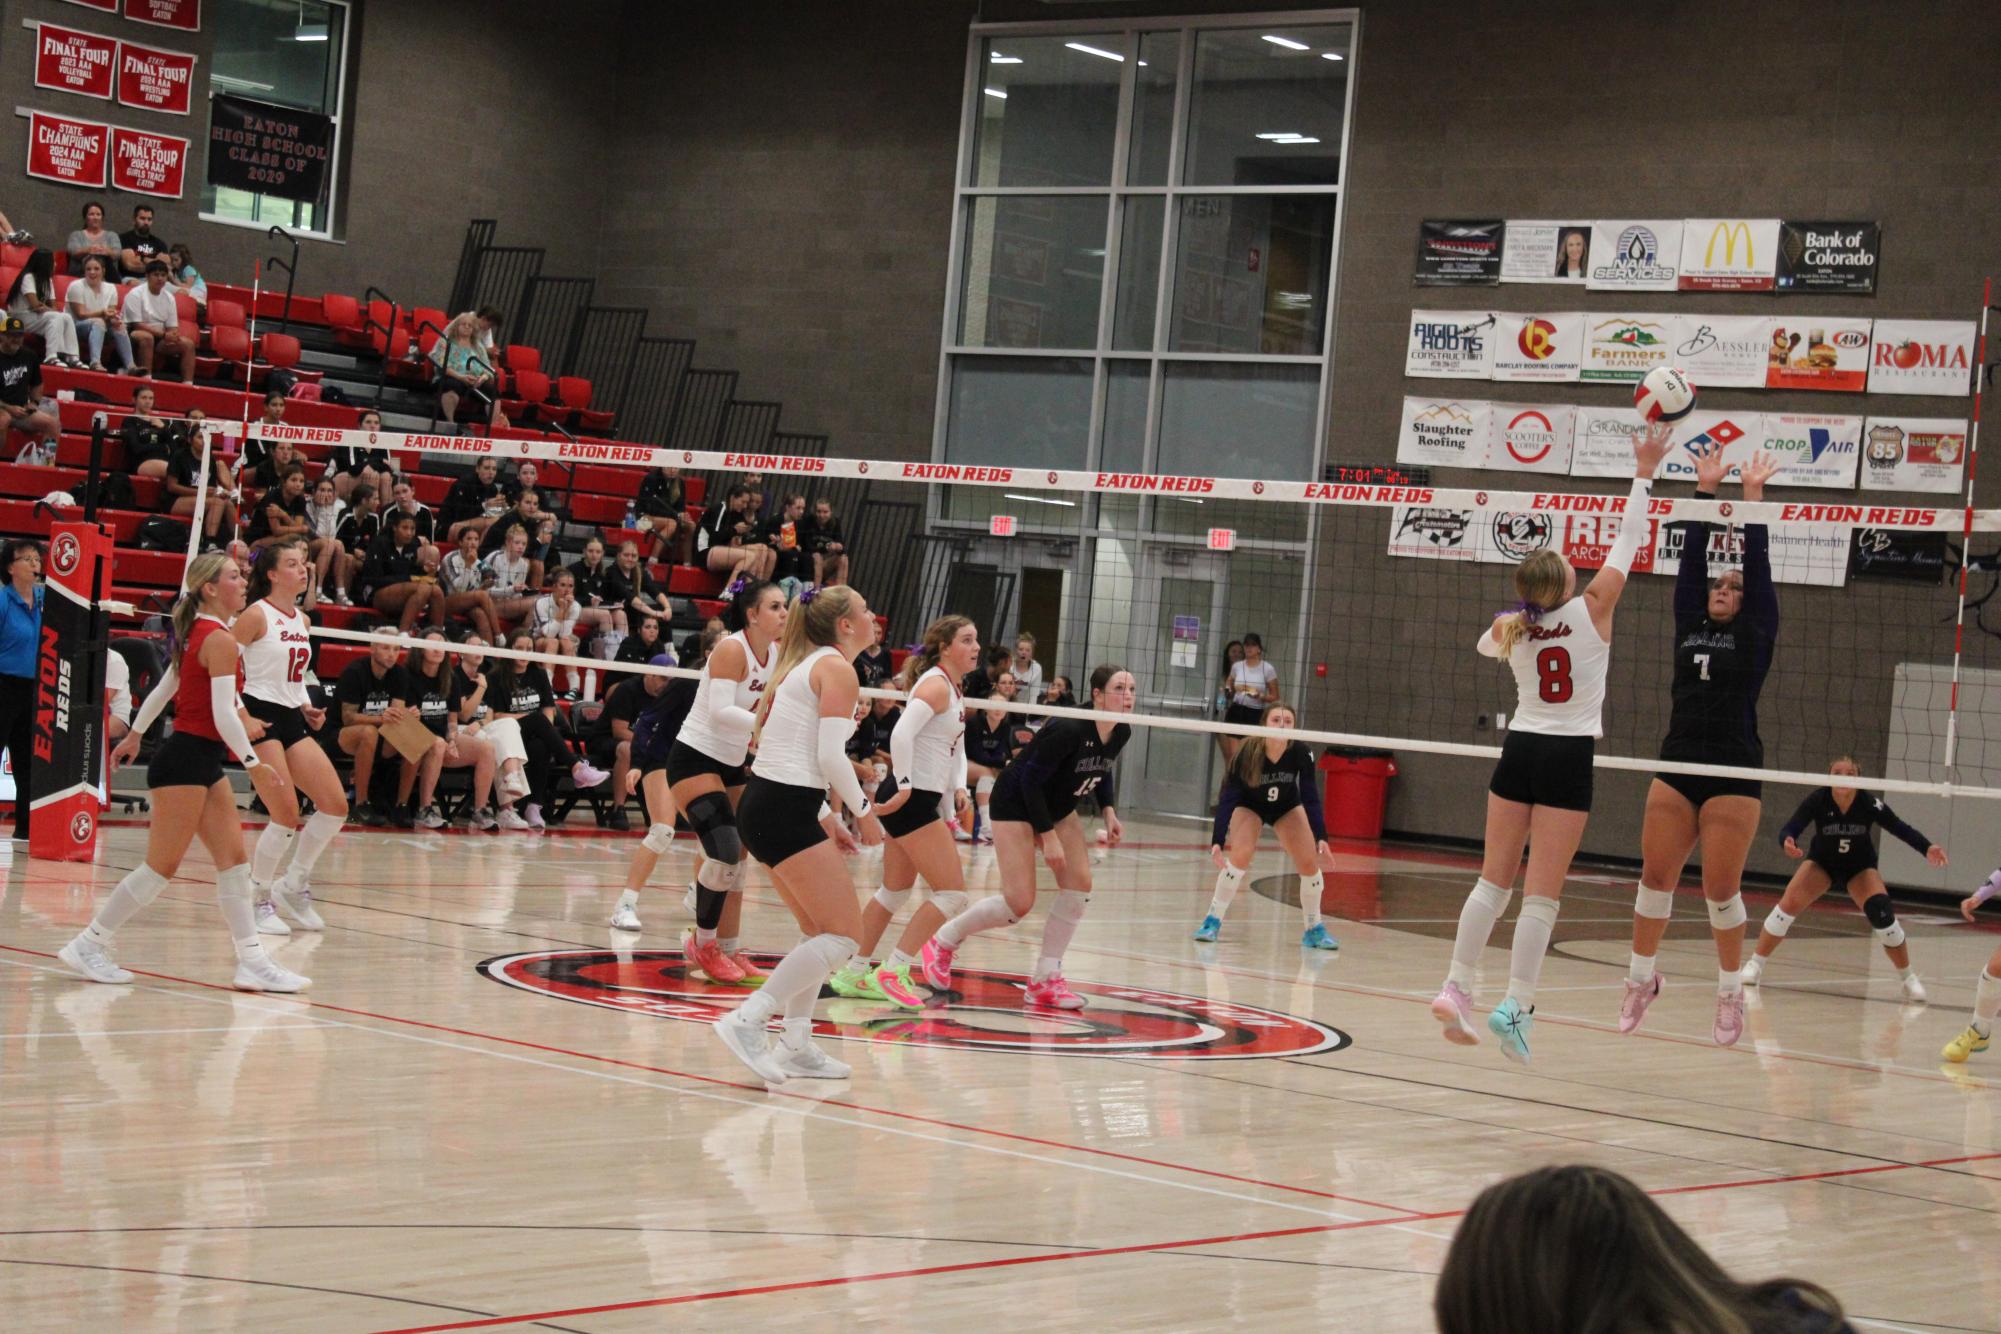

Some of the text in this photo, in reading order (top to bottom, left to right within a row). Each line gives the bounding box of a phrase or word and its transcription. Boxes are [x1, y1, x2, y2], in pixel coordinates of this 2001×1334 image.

[149, 2, 177, 12] SOFTBALL
[153, 10, 172, 20] EATON
[68, 37, 88, 48] STATE
[44, 37, 110, 66] FINAL FOUR
[60, 58, 92, 70] 2023 AAA
[147, 56, 167, 66] STATE
[58, 66, 92, 80] VOLLEYBALL
[124, 56, 188, 84] FINAL FOUR
[66, 76, 84, 86] EATON
[157, 78, 171, 88] AAA
[140, 84, 171, 97] WRESTLING
[145, 94, 164, 104] EATON
[58, 124, 84, 136] STATE
[243, 116, 300, 138] EATON
[39, 125, 99, 154] CHAMPIONS
[138, 136, 162, 150] STATE
[212, 126, 328, 160] HIGH SCHOOL
[50, 146, 85, 161] 2024 AAA
[118, 139, 178, 168] FINAL FOUR
[228, 146, 308, 173] CLASS OF
[52, 158, 82, 170] BASEBALL
[58, 167, 76, 177] EATON
[131, 158, 166, 173] 2024 AAA
[126, 167, 166, 183] GIRLS TRACK
[248, 166, 286, 185] 2029
[136, 179, 156, 190] EATON
[1805, 230, 1864, 248] Bank of
[1804, 248, 1874, 266] Colorado
[1594, 266, 1675, 280] SERVICES
[1411, 352, 1483, 360] CONSTRUCTION
[1592, 348, 1666, 360] Farmers
[1874, 341, 1970, 369] ROMA
[1606, 359, 1652, 367] BANK
[1874, 368, 1967, 378] RESTAURANT
[261, 424, 343, 442] EATON REDS
[1413, 422, 1474, 436] Slaughter
[404, 434, 492, 452] EATON REDS
[1418, 436, 1466, 450] Roofing
[1764, 438, 1854, 453] CROP AIR
[1872, 443, 1896, 459] 85
[558, 444, 652, 462] EATON REDS
[723, 453, 826, 472] EATON REDS
[902, 464, 1014, 482] EATON REDS
[1340, 468, 1370, 482] 7:01
[1095, 472, 1215, 493] EATON REDS
[1304, 483, 1434, 504] EATON REDS
[1531, 494, 1674, 515] EATON RDS
[1780, 504, 1937, 526] EATON REDS
[993, 516, 1012, 535] EXIT
[1570, 516, 1652, 548] RB
[1212, 528, 1231, 548] EXIT
[1664, 528, 1745, 554] TUKEY
[1771, 534, 1845, 548] Banner Health
[1858, 528, 1892, 552] CB
[1568, 545, 1648, 564] ARCHTS
[1660, 549, 1742, 563] BUERS
[280, 630, 309, 642] Eaton
[1527, 621, 1572, 642] Reds
[288, 648, 310, 682] 12
[1694, 654, 1711, 680] 7
[1536, 646, 1574, 704] 8
[34, 625, 60, 765] EATON
[56, 658, 72, 733] REDS
[1073, 777, 1102, 796] 15
[1267, 786, 1279, 802] 9
[1838, 838, 1851, 854] 5
